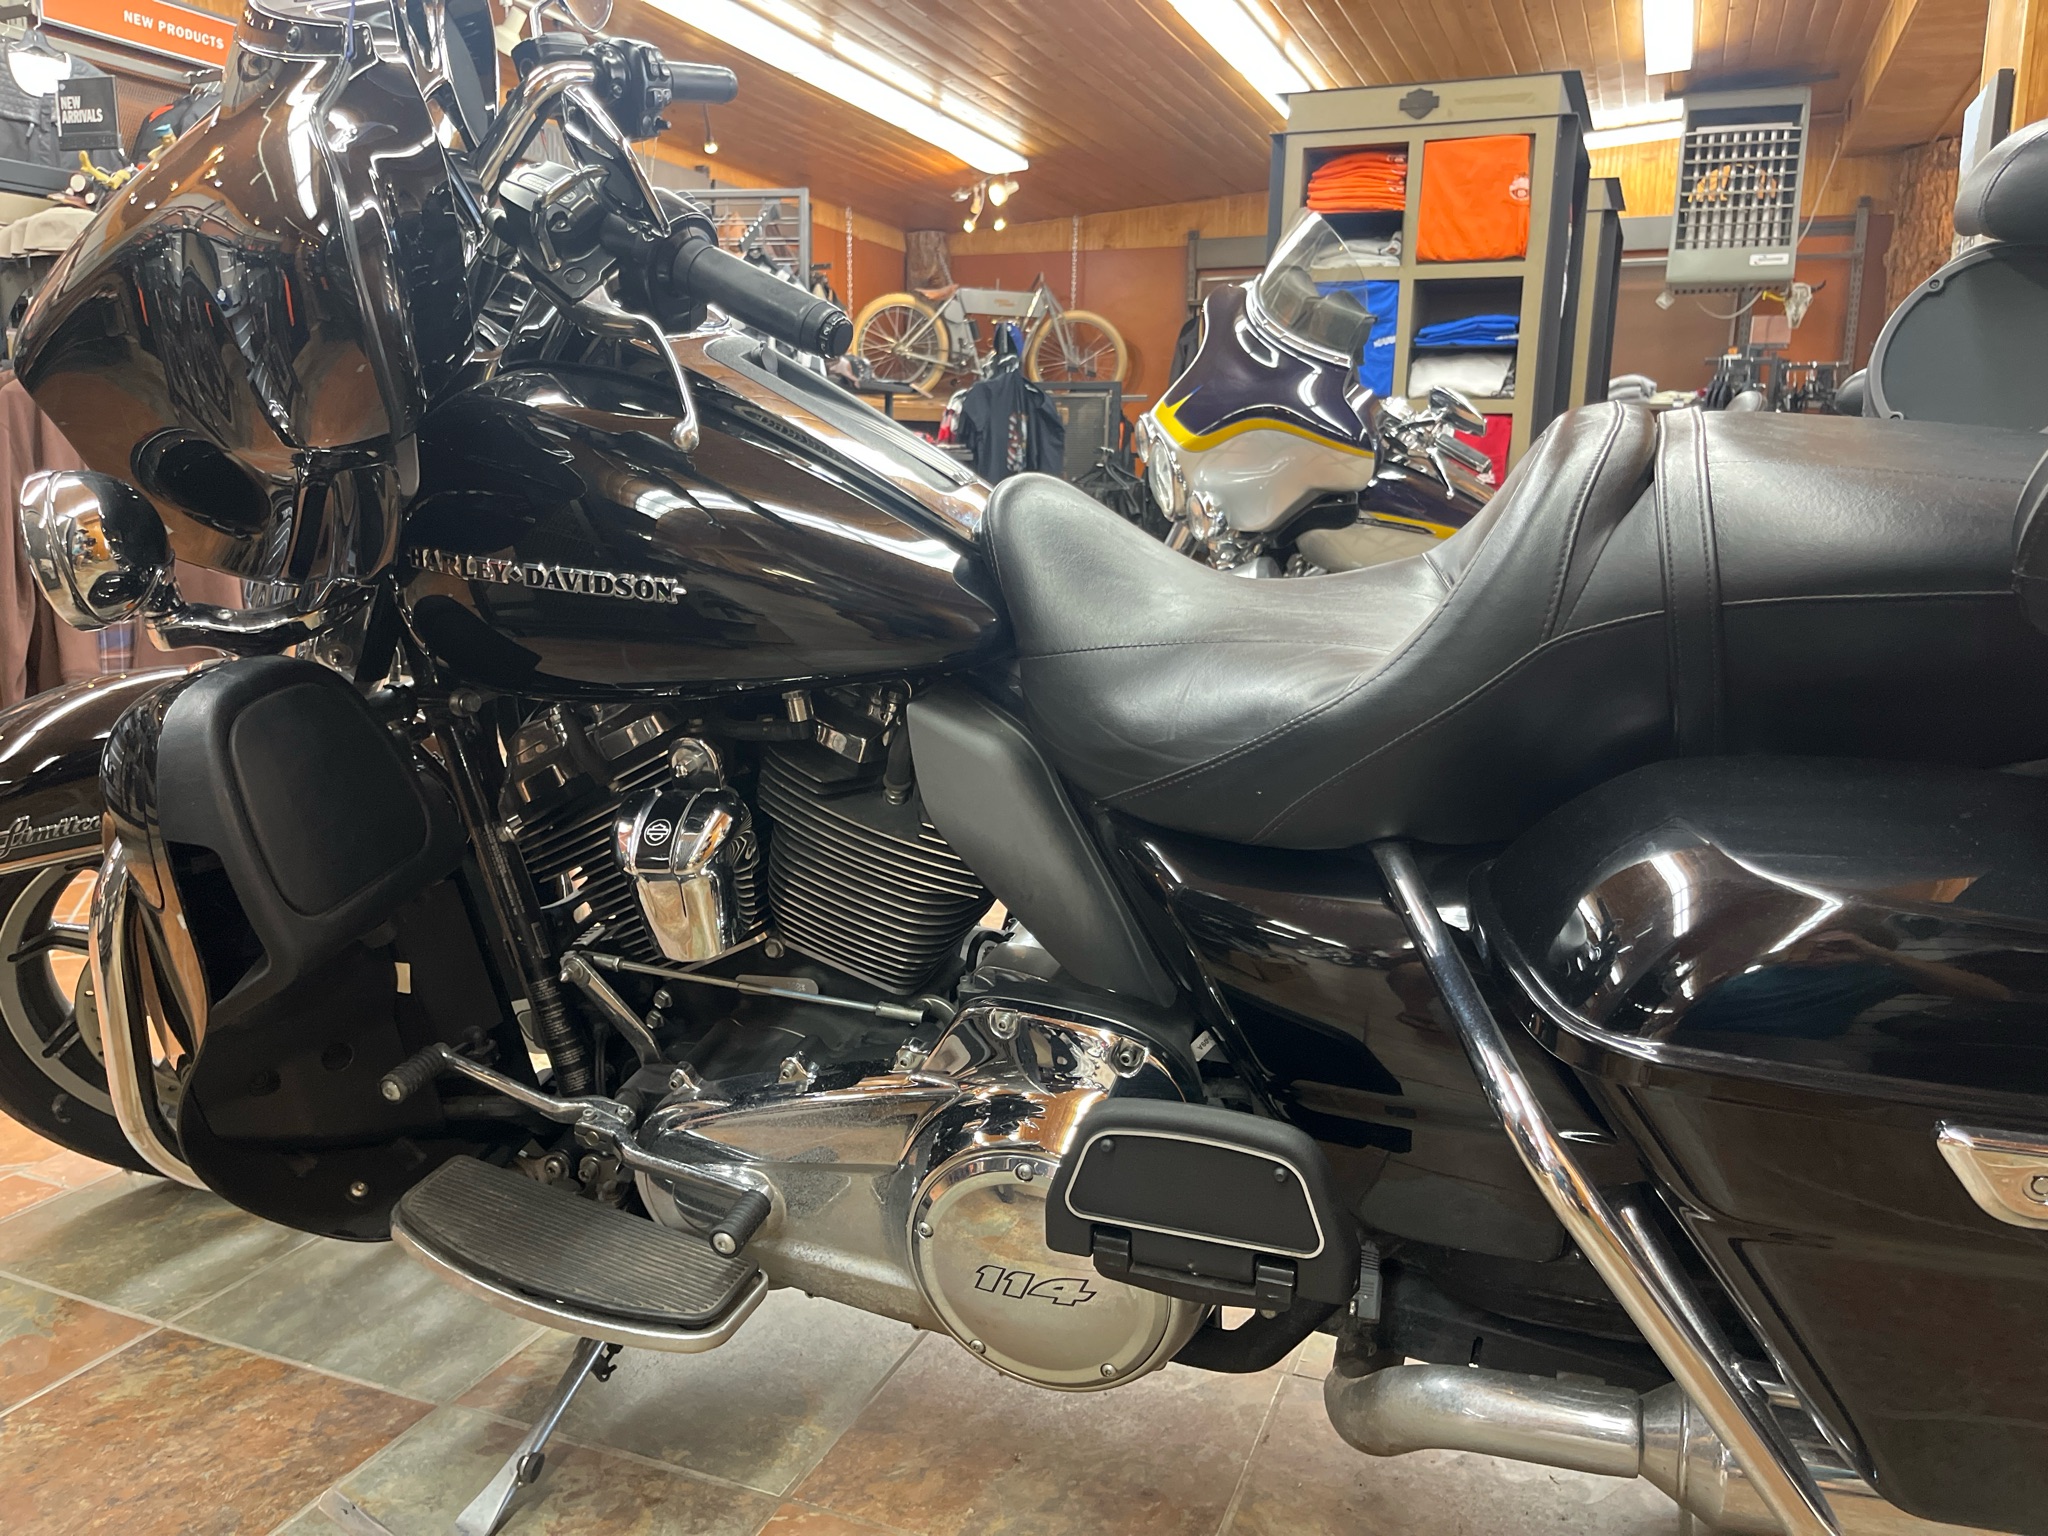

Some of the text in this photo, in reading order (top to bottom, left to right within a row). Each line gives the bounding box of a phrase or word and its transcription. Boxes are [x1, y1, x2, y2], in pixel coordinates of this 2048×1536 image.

[124, 10, 224, 49] NEW PRODUCTS
[60, 95, 81, 110] NEW
[61, 108, 103, 124] ARRIVALS
[974, 1264, 1097, 1307] 114
